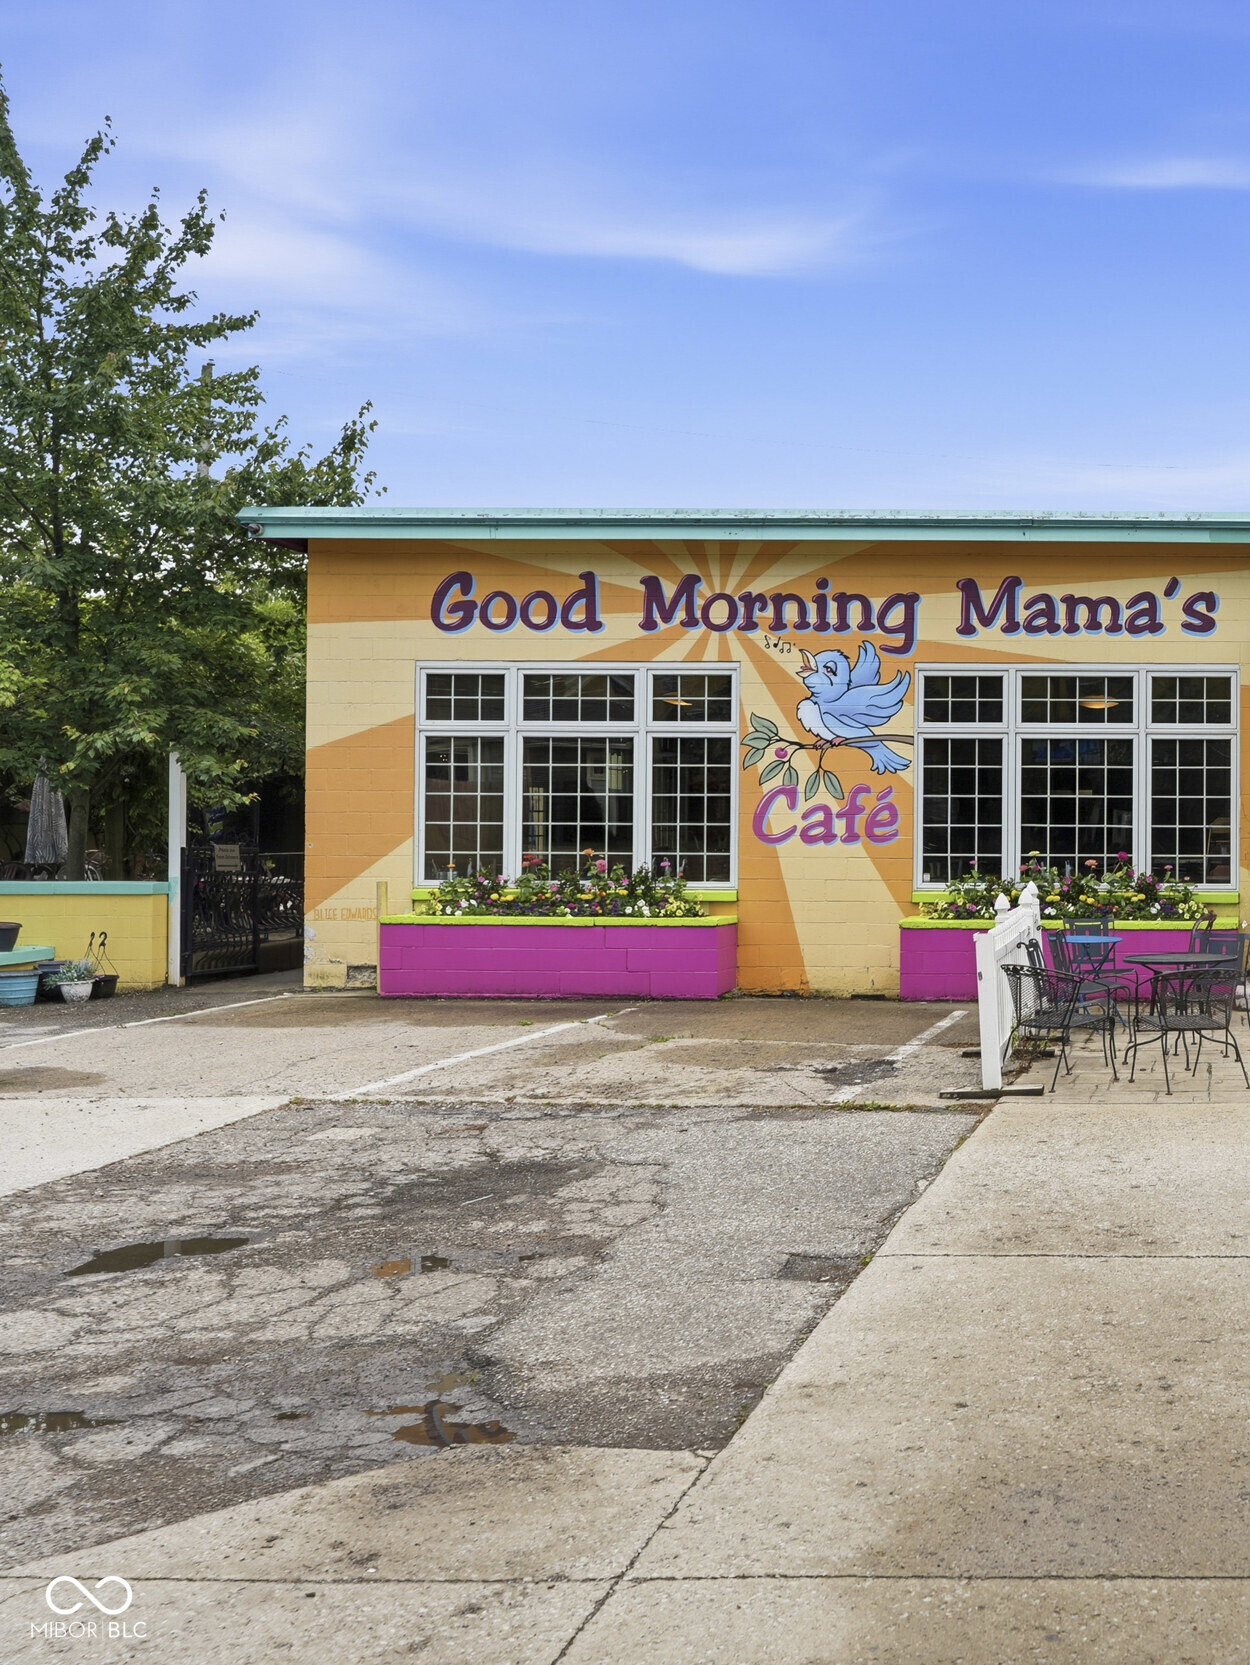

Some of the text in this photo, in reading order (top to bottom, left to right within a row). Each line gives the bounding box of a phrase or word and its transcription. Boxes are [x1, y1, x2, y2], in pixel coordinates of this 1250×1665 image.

[430, 571, 1220, 656] Good Morning Mama's
[752, 783, 900, 845] Café
